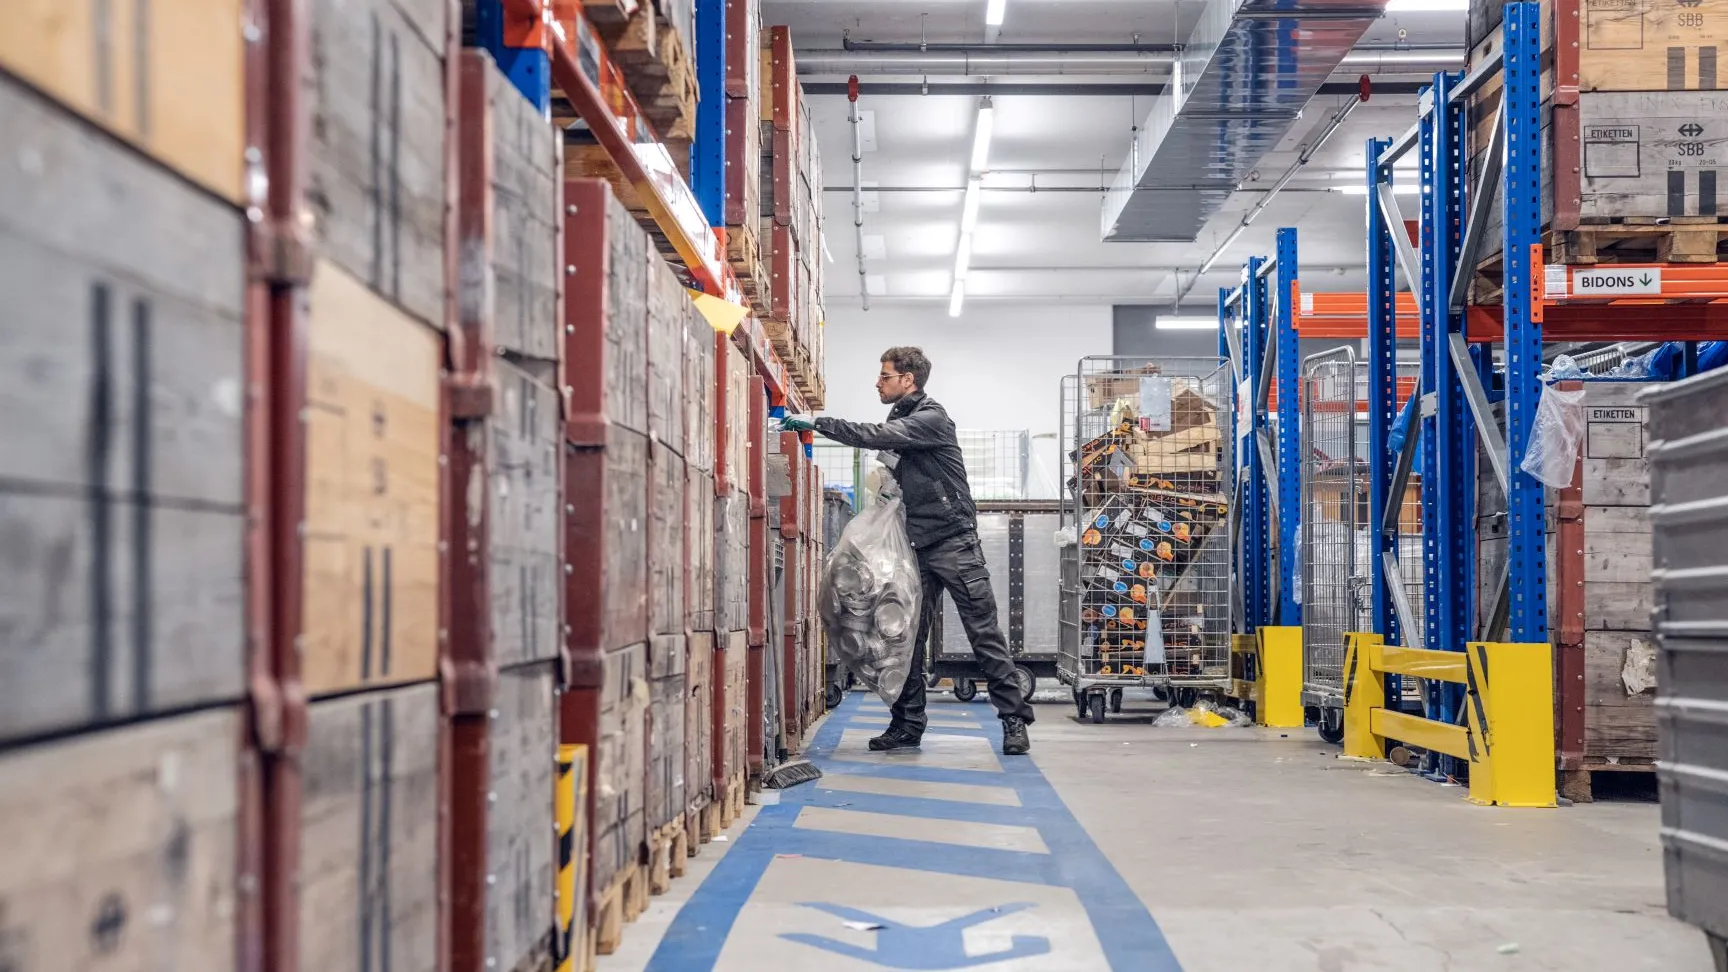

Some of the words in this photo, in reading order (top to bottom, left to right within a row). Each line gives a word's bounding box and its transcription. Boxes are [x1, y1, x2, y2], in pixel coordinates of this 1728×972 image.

[1678, 13, 1704, 27] SBB
[1591, 129, 1633, 138] ETIKETTEN
[1678, 142, 1705, 156] SBB
[1582, 276, 1635, 288] BIDONS
[1593, 410, 1635, 419] ETIKETTEN
